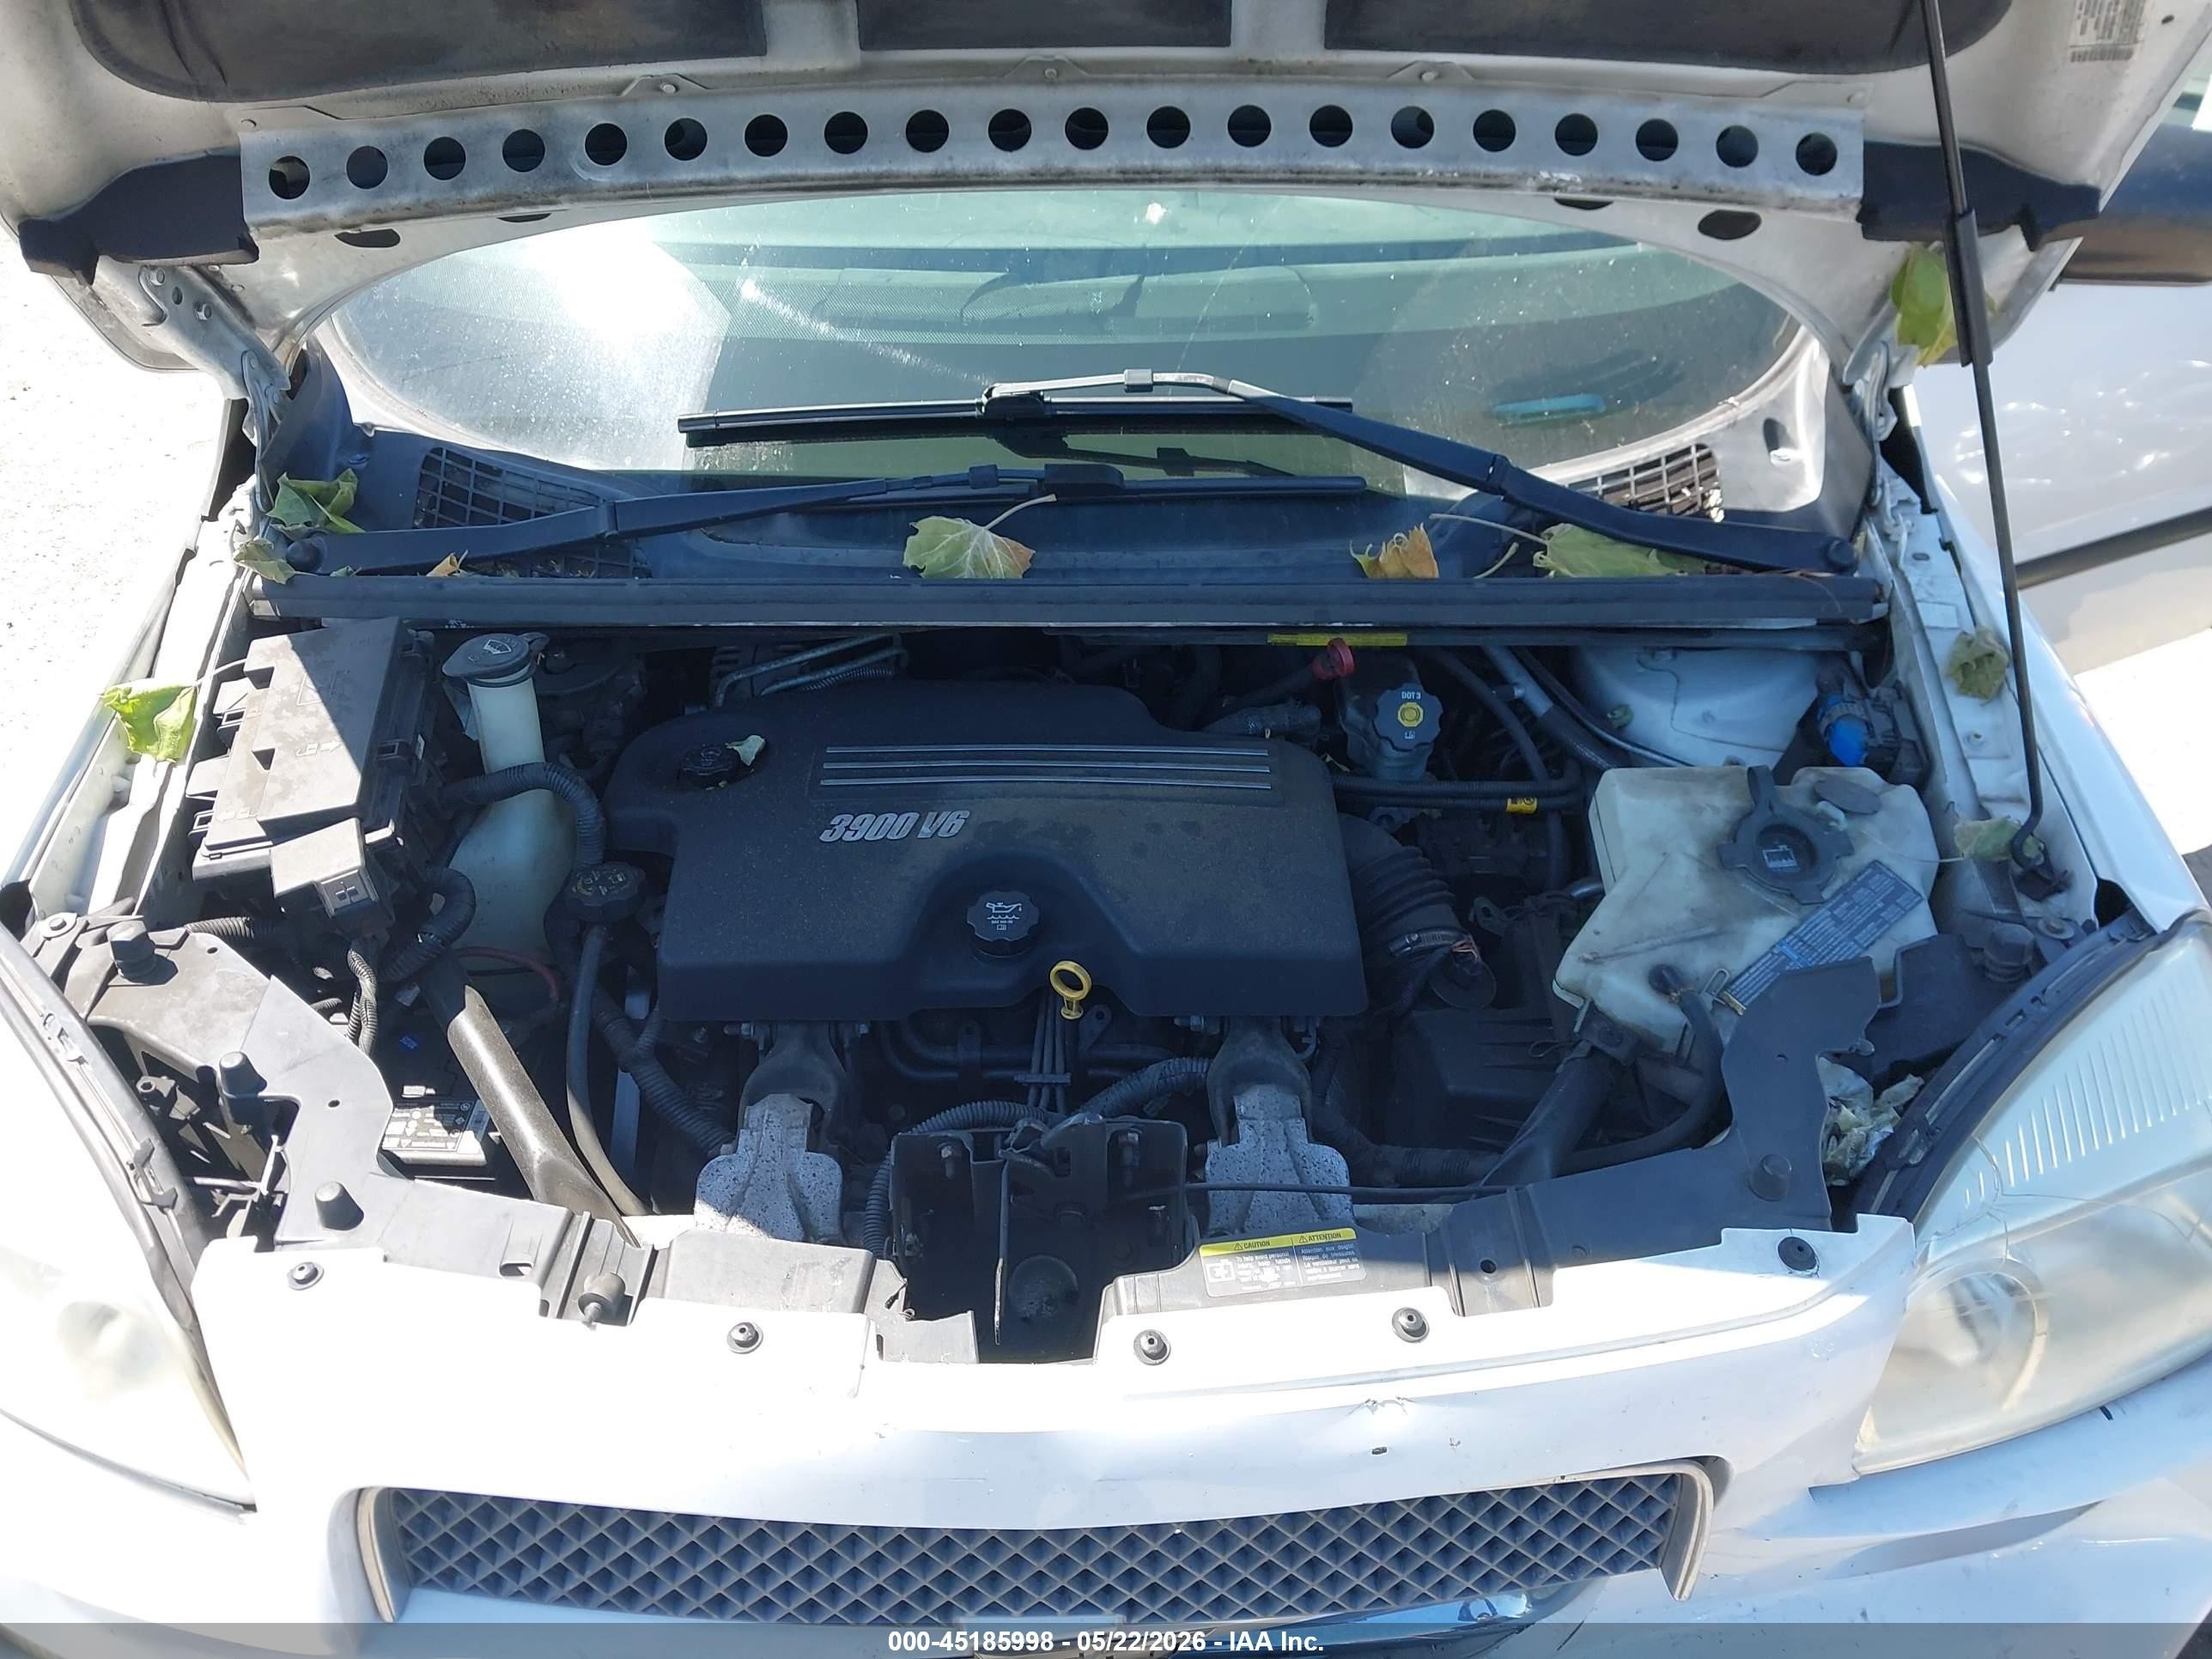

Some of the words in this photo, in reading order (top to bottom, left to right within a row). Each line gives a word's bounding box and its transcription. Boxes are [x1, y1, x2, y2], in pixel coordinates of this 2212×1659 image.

[818, 811, 921, 843] 3900
[916, 810, 971, 839] V6
[1308, 1232, 1341, 1242] ATTENTION
[1243, 1240, 1271, 1249] CAUTION
